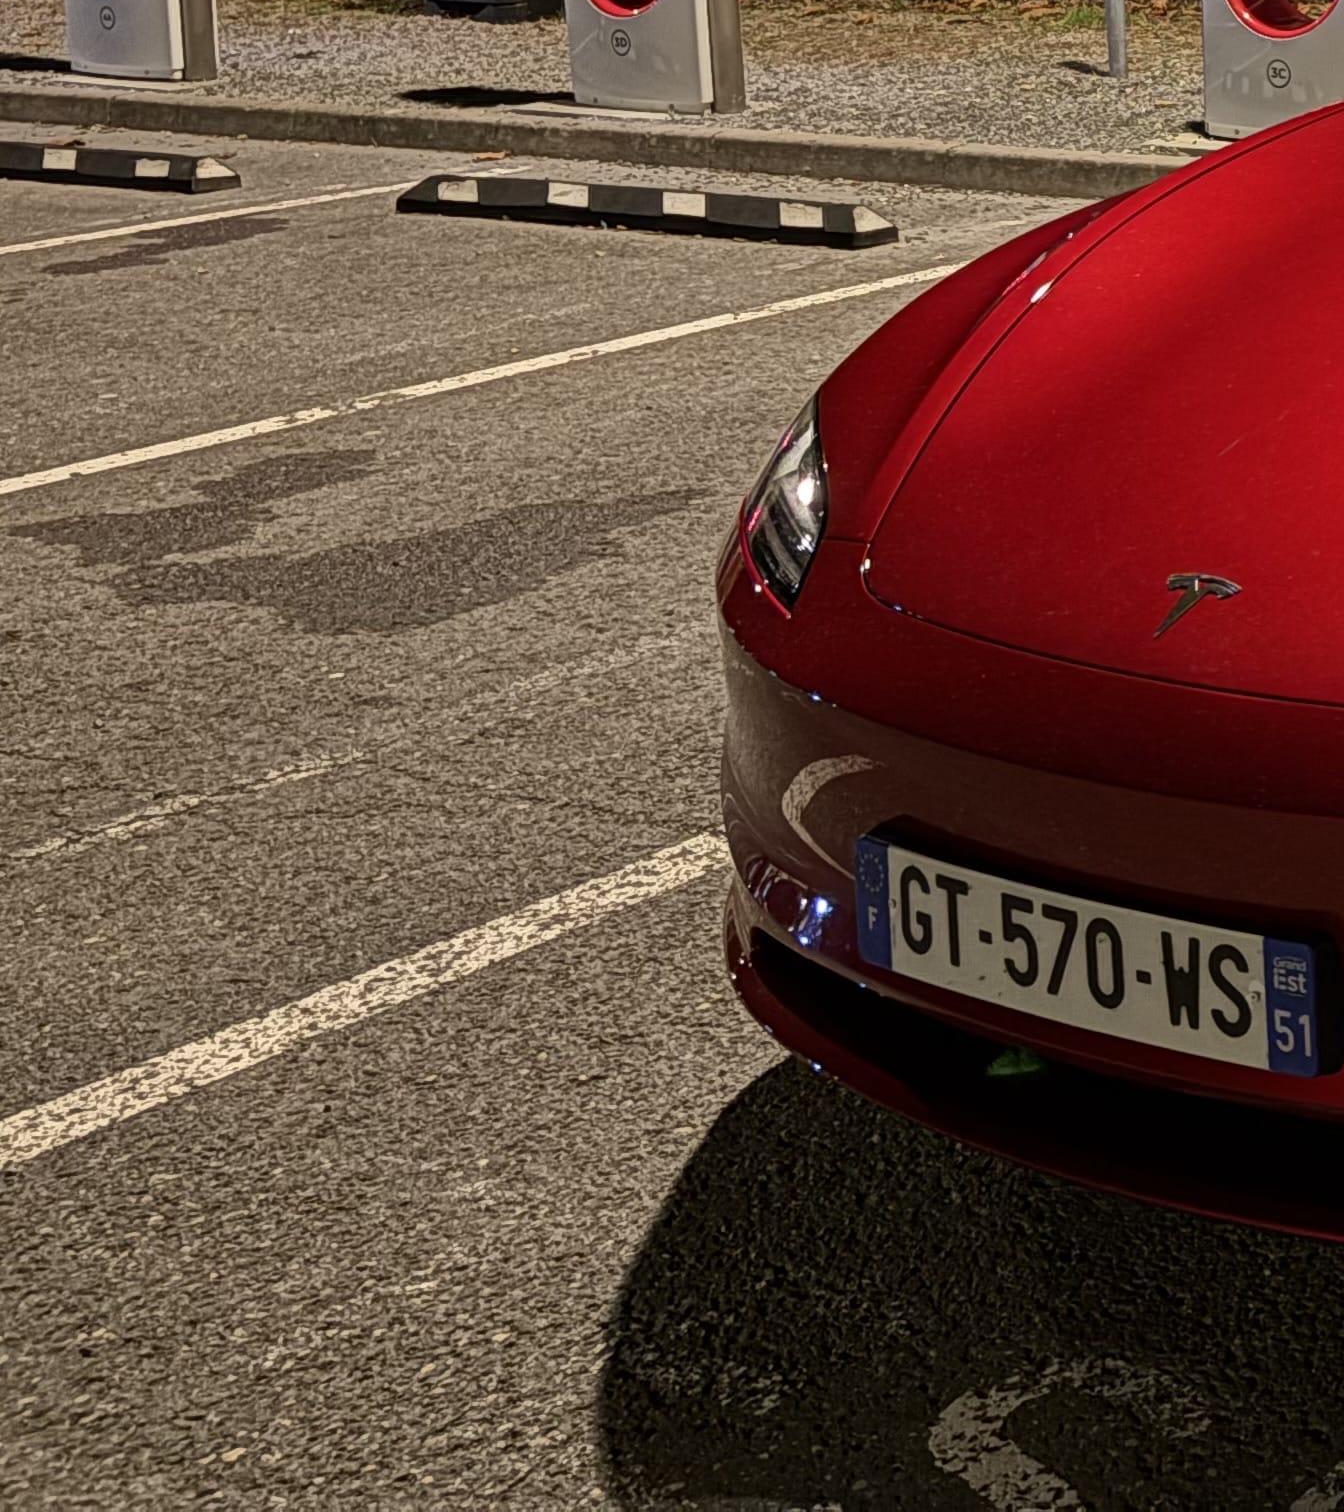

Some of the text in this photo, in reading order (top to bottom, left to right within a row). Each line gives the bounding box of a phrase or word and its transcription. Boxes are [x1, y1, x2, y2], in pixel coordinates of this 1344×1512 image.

[615, 36, 628, 48] 3D
[1271, 67, 1287, 80] 3C
[868, 905, 878, 930] F
[900, 865, 1253, 1038] GT-570-WS
[1273, 956, 1307, 972] Grand
[1273, 967, 1307, 994] Est
[1274, 1008, 1312, 1057] 51
